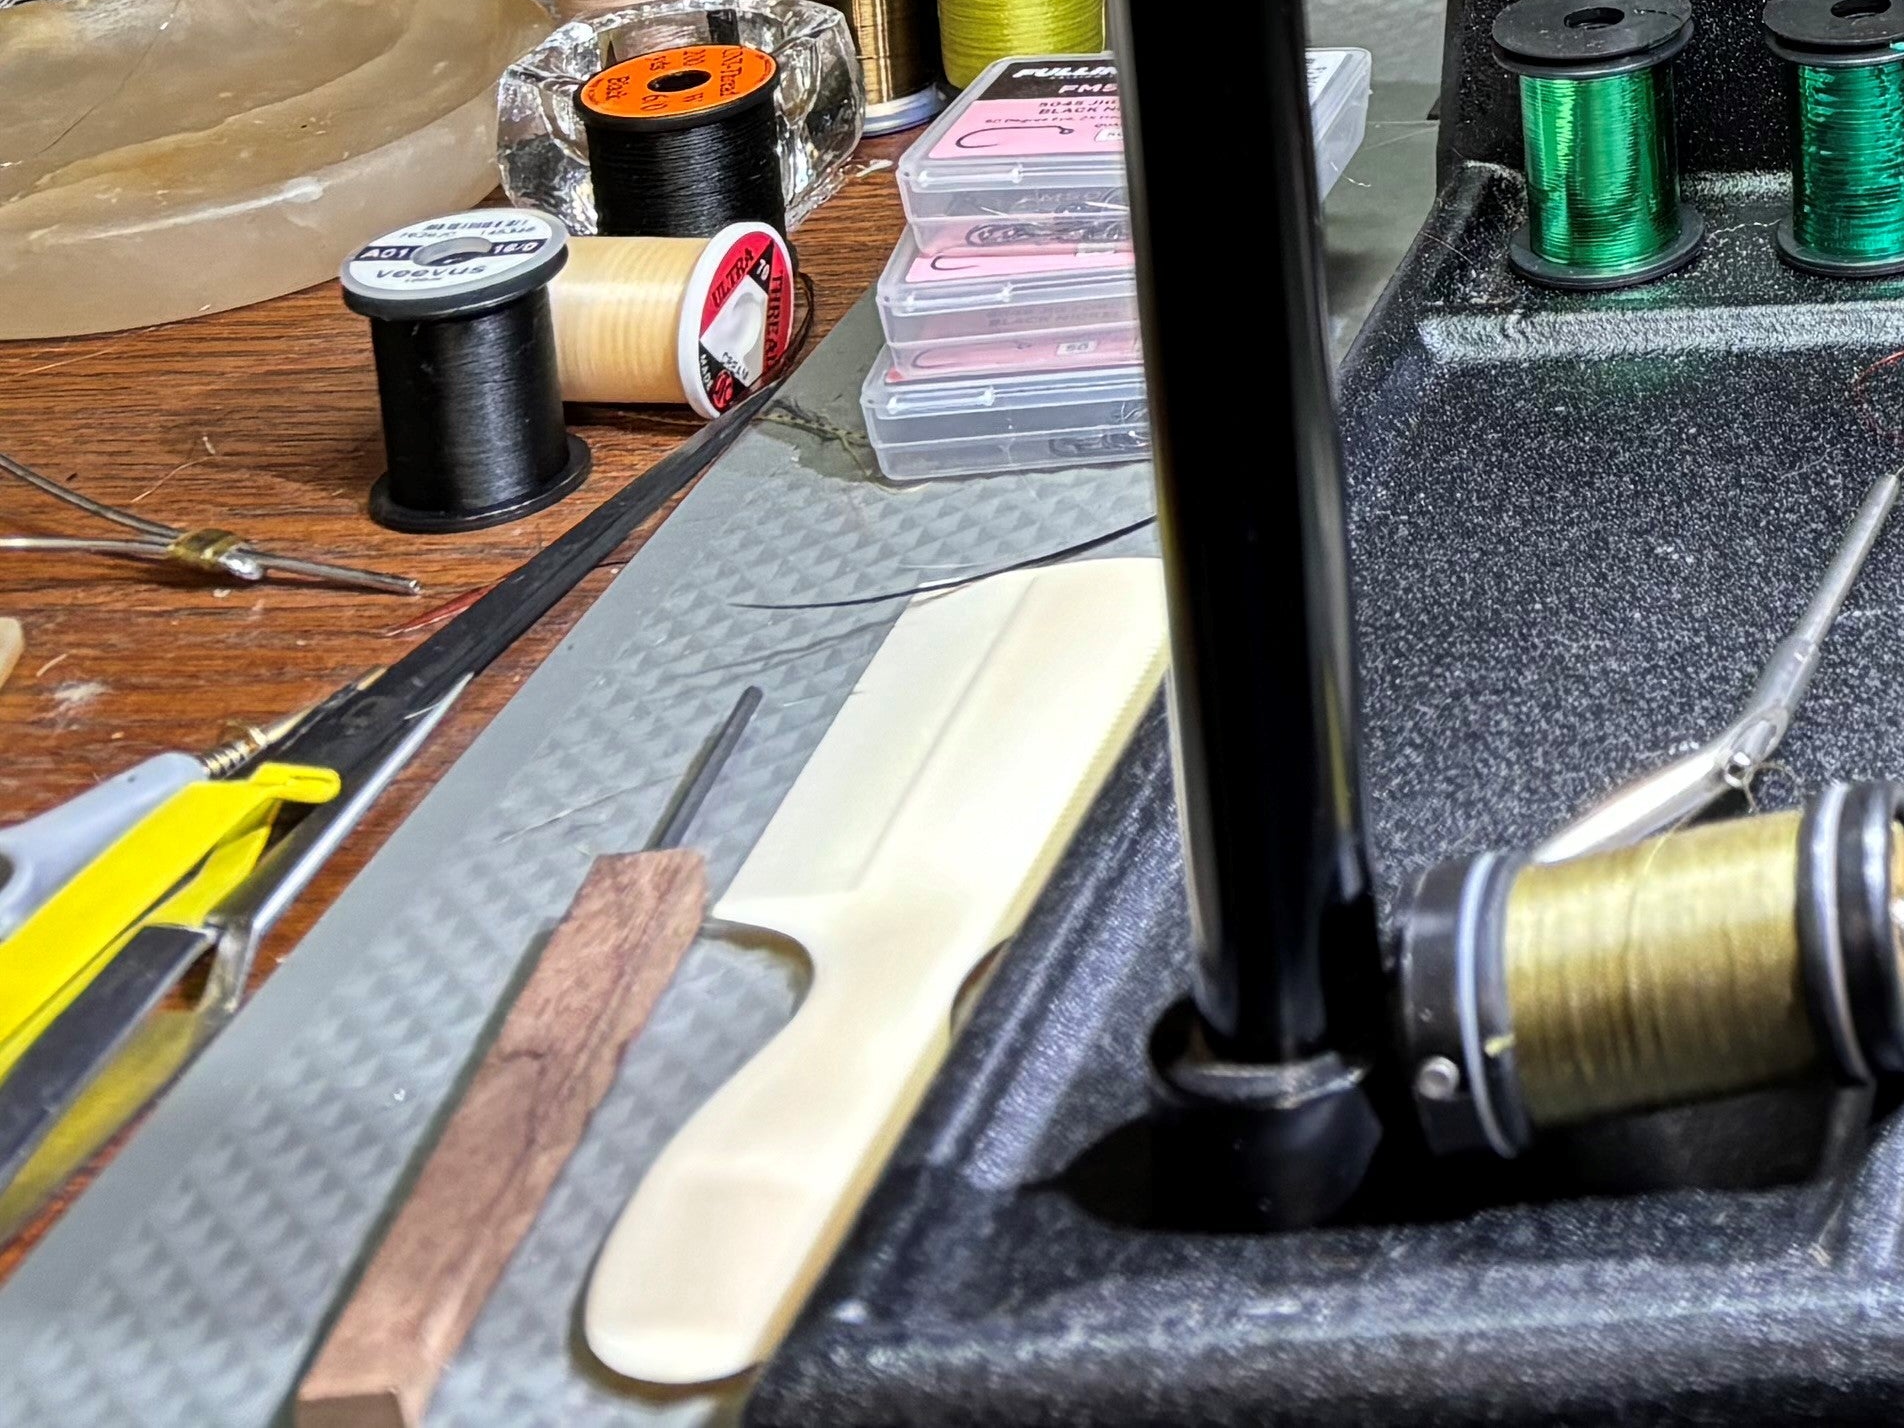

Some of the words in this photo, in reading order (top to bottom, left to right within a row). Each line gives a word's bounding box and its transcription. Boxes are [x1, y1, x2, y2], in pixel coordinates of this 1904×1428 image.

[719, 49, 745, 97] UNI-Thread
[1038, 107, 1094, 115] BLACK
[360, 248, 409, 259] A01
[711, 249, 755, 306] ULTRA
[756, 258, 770, 279] 70
